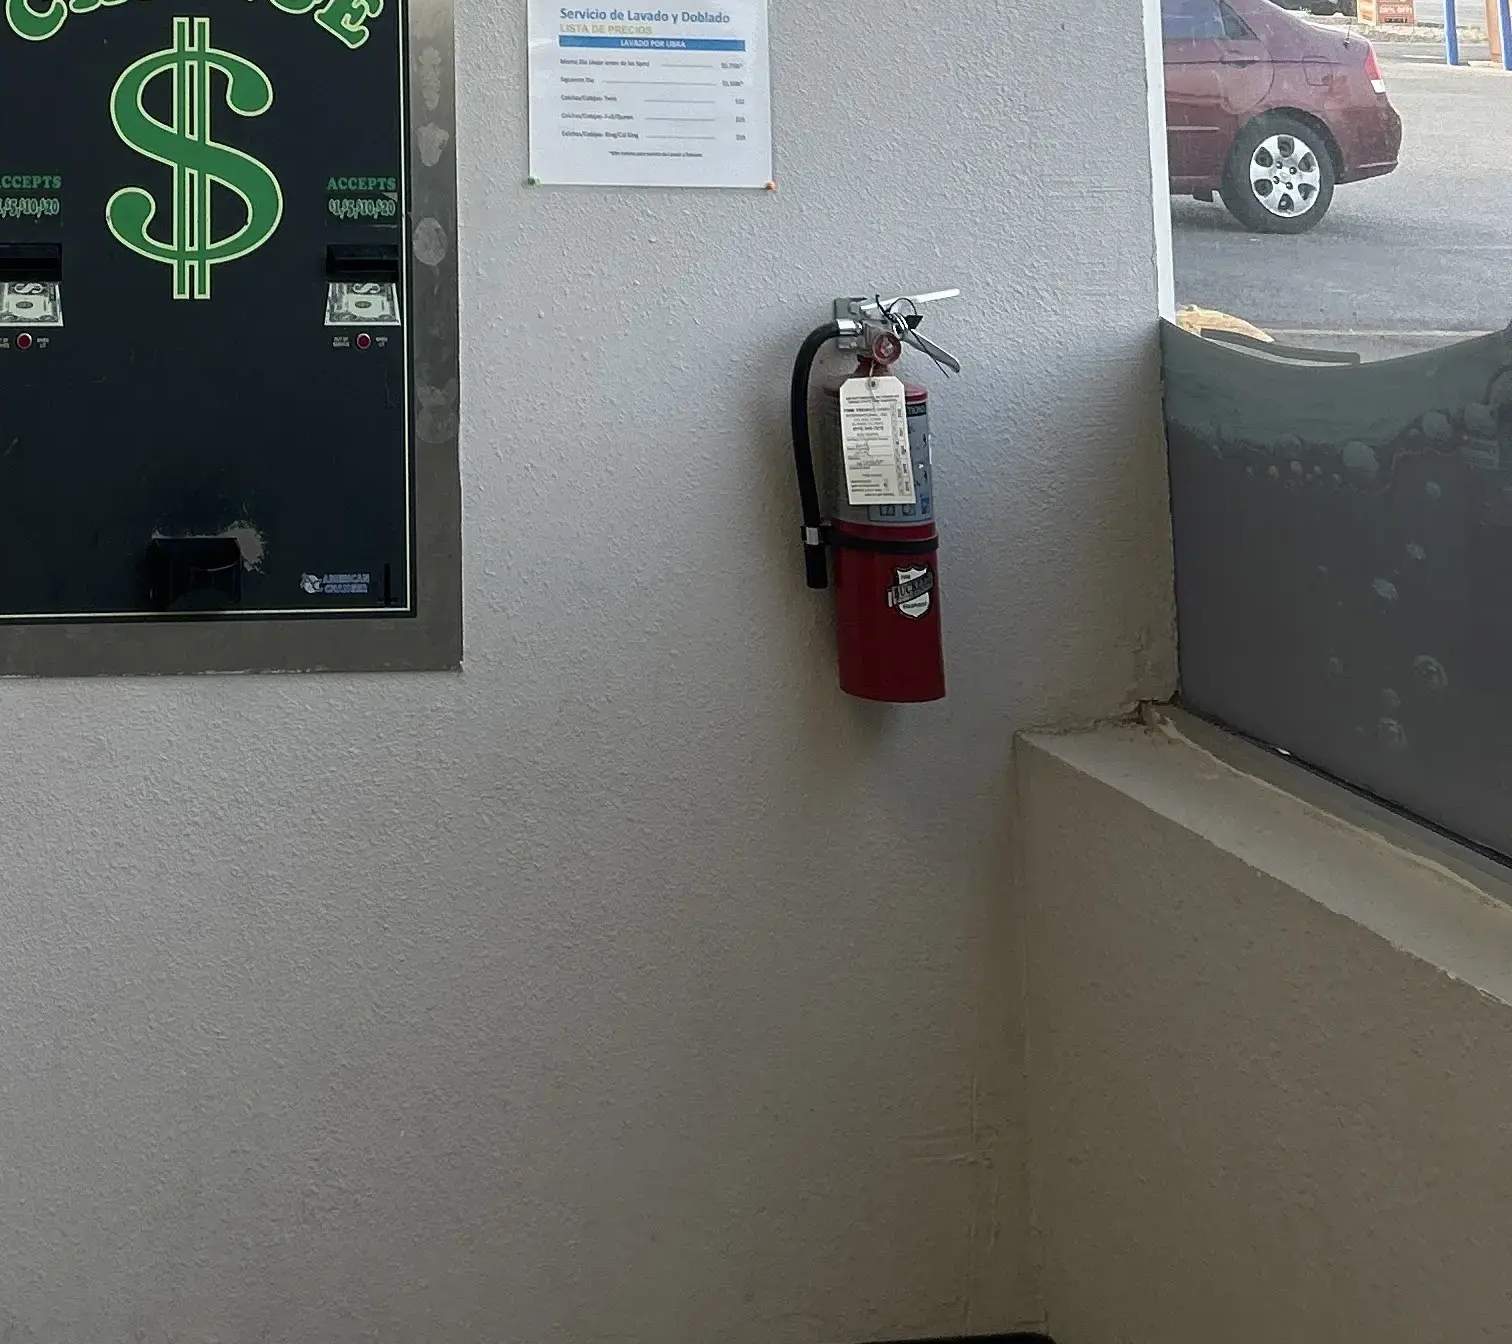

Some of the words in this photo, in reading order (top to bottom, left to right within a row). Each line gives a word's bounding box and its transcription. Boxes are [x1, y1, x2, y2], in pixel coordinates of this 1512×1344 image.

[560, 8, 607, 20] Servicio
[610, 9, 624, 21] de
[628, 10, 669, 22] Lavado
[671, 13, 678, 24] y
[682, 12, 730, 24] Doblado
[560, 24, 588, 33] LISTA
[591, 25, 605, 34] DE
[608, 26, 652, 35] PRECIOS
[327, 177, 396, 190] ACCEPTS
